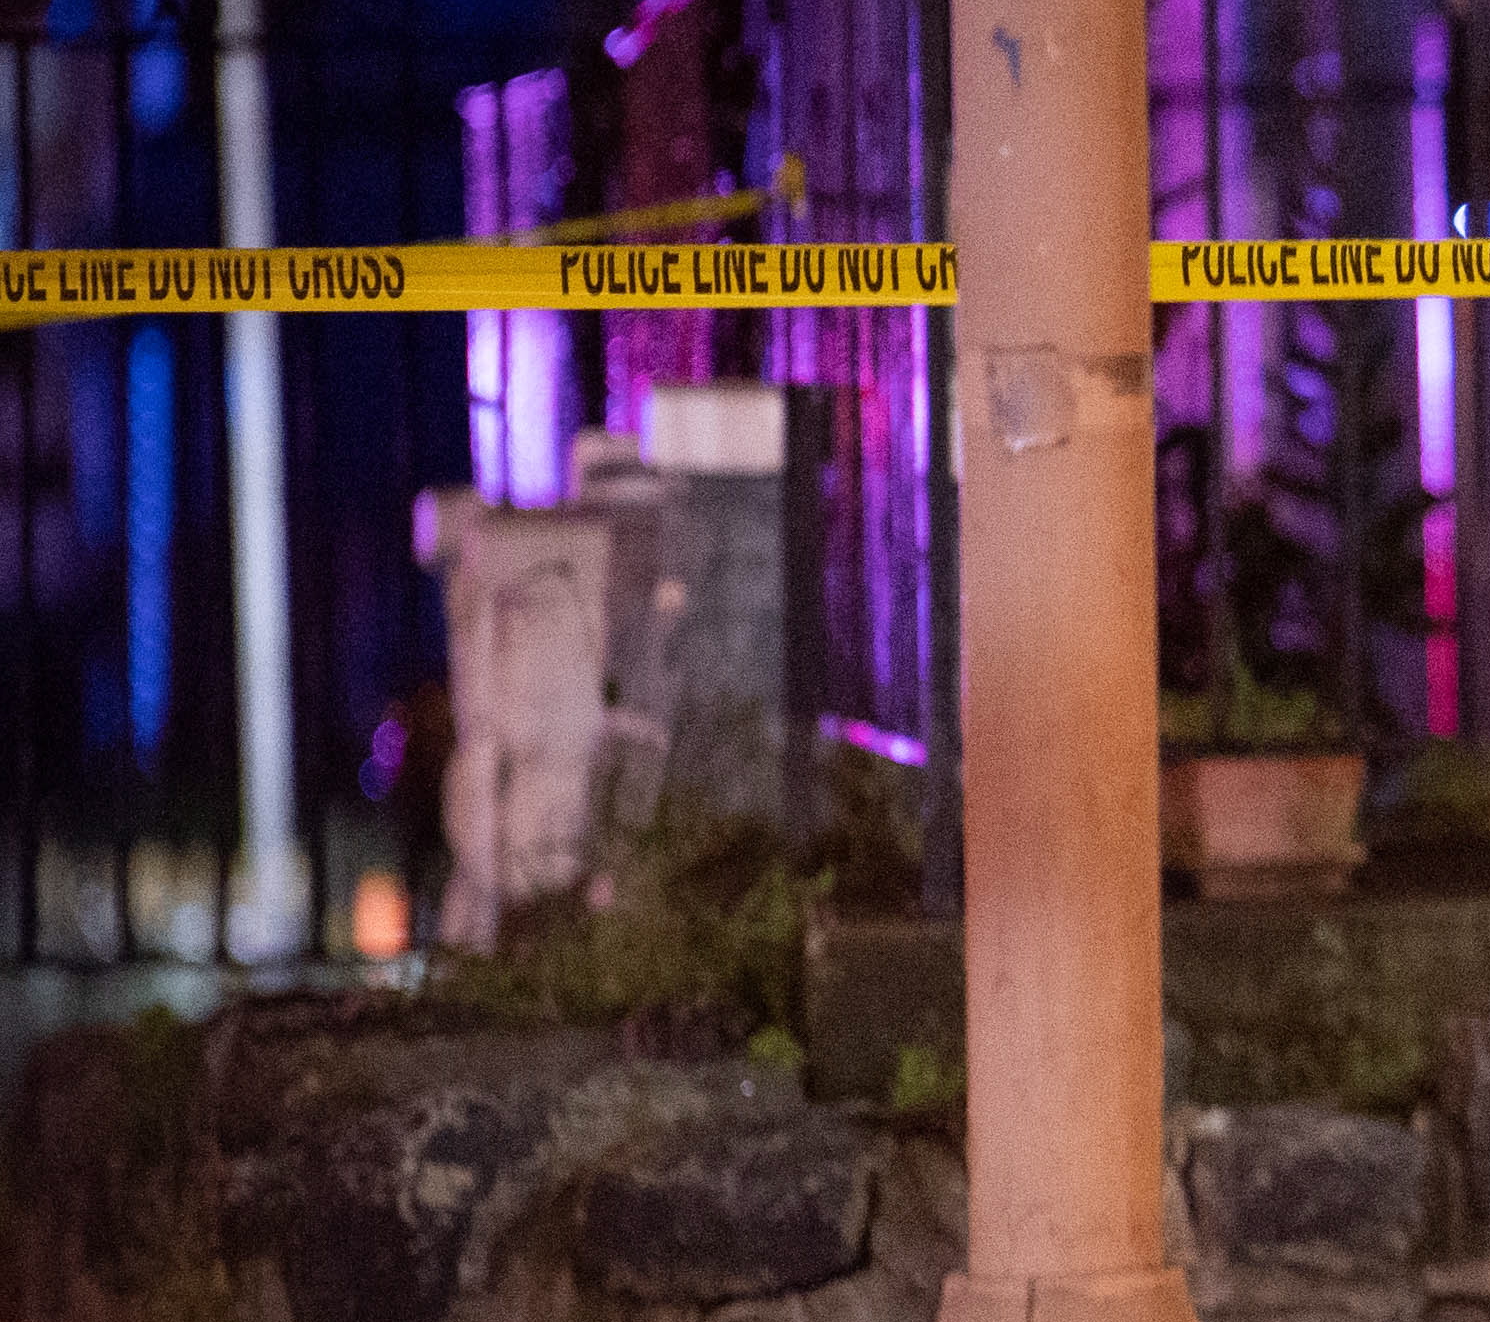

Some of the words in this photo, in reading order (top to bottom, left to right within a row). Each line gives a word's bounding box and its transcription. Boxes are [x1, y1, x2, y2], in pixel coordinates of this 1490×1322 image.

[0, 260, 48, 303] CE
[59, 258, 135, 302] LINE
[148, 257, 196, 301] DO
[209, 256, 275, 301] NOT
[288, 254, 406, 300] CROSS
[561, 250, 682, 296] POLICE
[694, 249, 769, 294] LINE
[780, 248, 825, 294] DO
[838, 248, 900, 293] NOT
[1181, 245, 1300, 287] POLICE
[1310, 244, 1385, 285] LINE
[1395, 244, 1440, 284] DO
